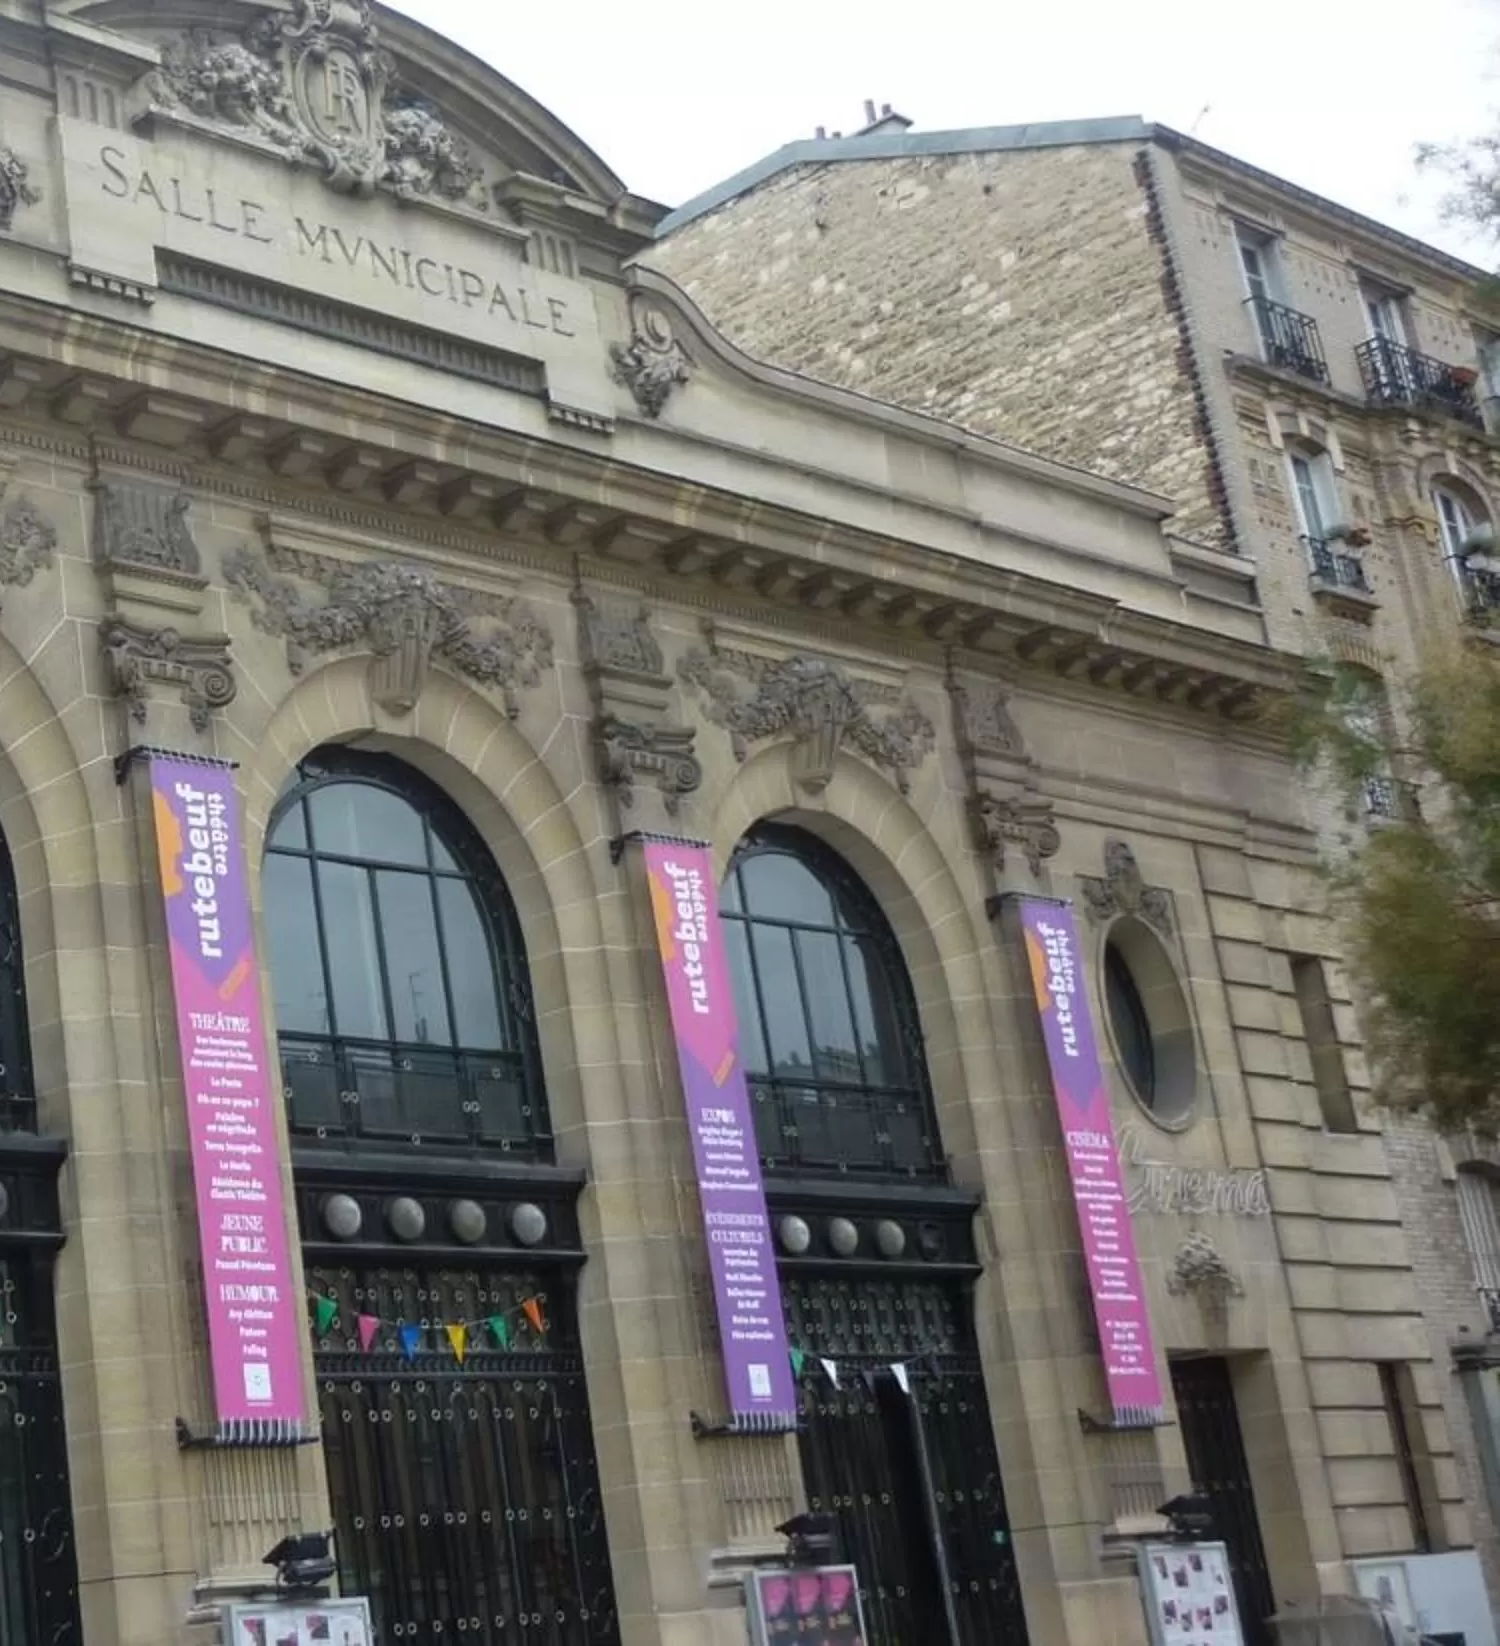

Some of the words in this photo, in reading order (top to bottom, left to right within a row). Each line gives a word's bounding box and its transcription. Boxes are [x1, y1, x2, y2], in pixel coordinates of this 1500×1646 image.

[99, 145, 274, 244] SALLE
[293, 216, 575, 338] MVNICIPALE
[175, 782, 222, 958] rutebeuf
[207, 792, 228, 875] théâtre
[663, 861, 709, 1014] rutebeuf
[1036, 920, 1079, 1057] rutebeuf
[220, 1236, 268, 1254] PUBLIC
